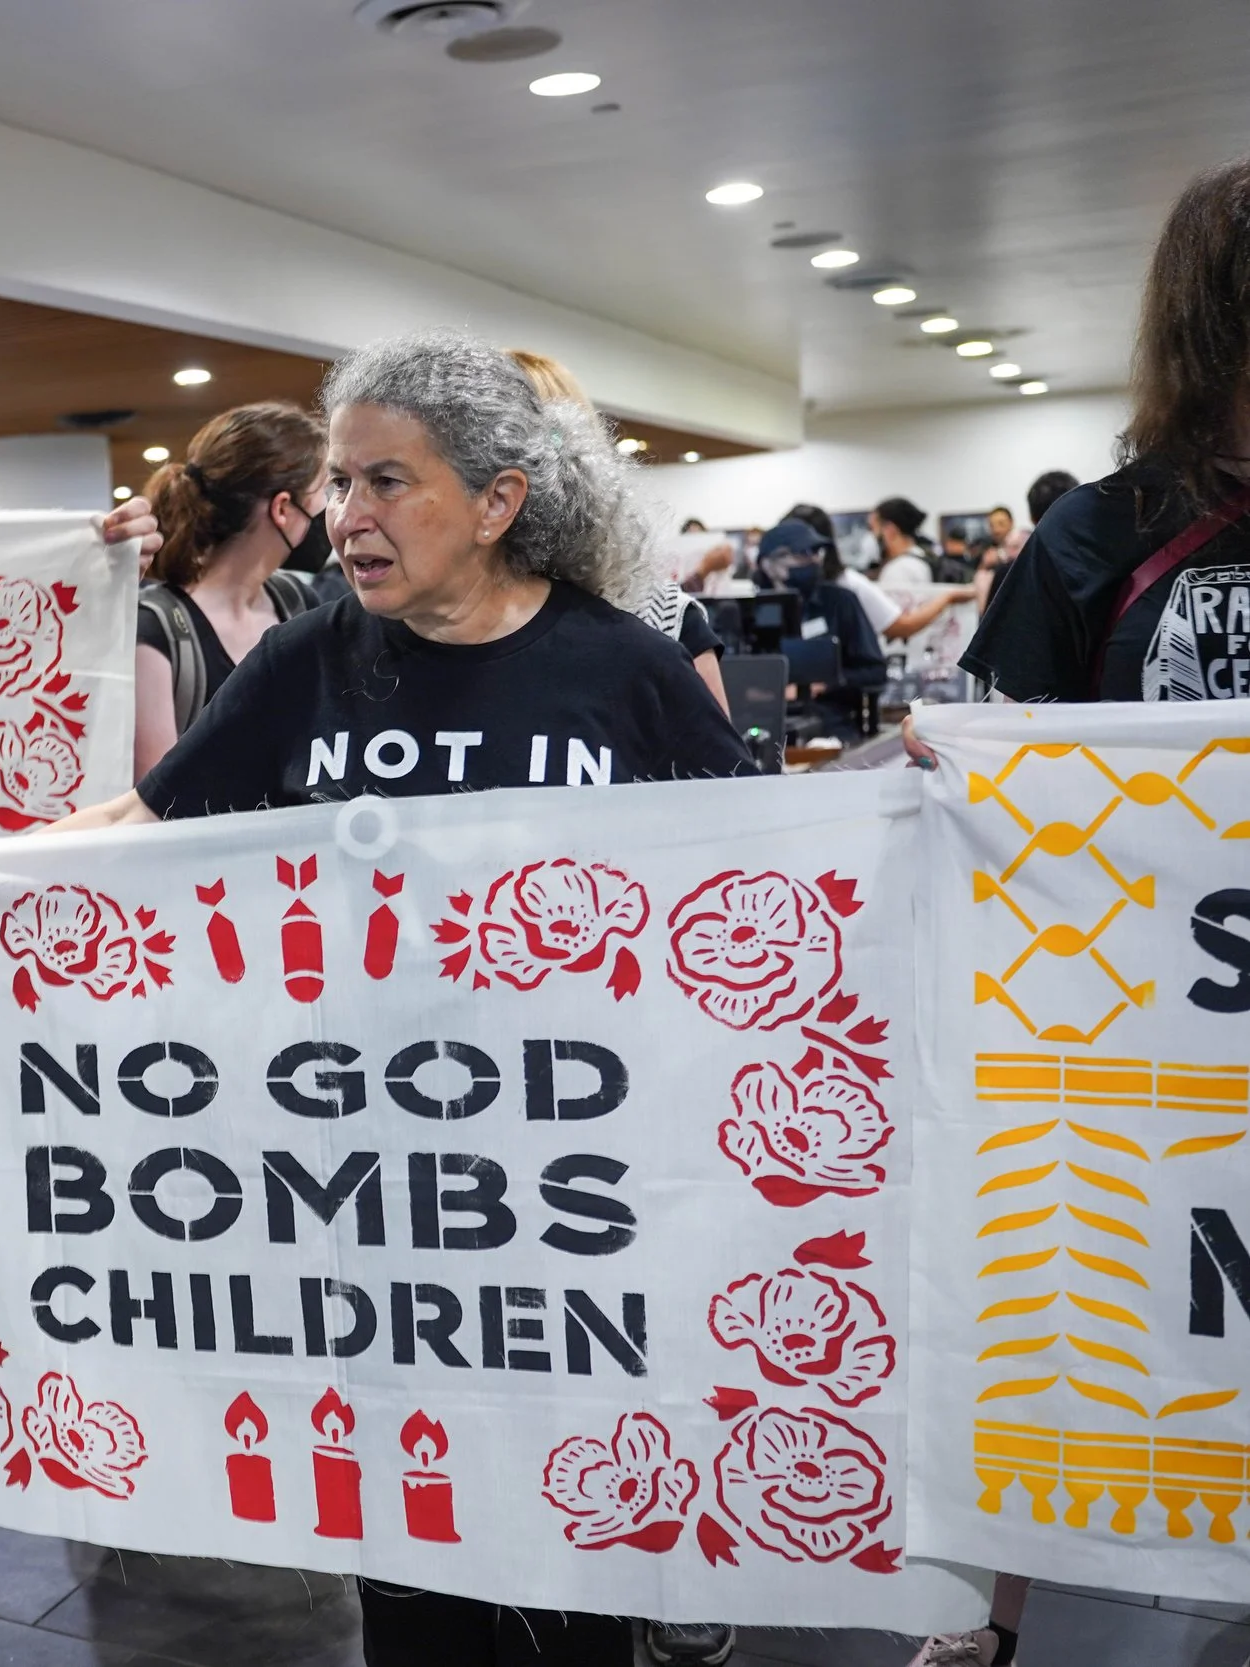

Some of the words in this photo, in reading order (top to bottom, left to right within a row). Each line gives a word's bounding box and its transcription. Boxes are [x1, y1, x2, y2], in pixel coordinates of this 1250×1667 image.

[305, 729, 484, 787] NOT
[528, 734, 613, 788] IN
[20, 1040, 220, 1119] NO
[266, 1038, 631, 1122] GOD
[25, 1144, 638, 1256] BOMBS
[30, 1265, 648, 1378] CHILDREN
